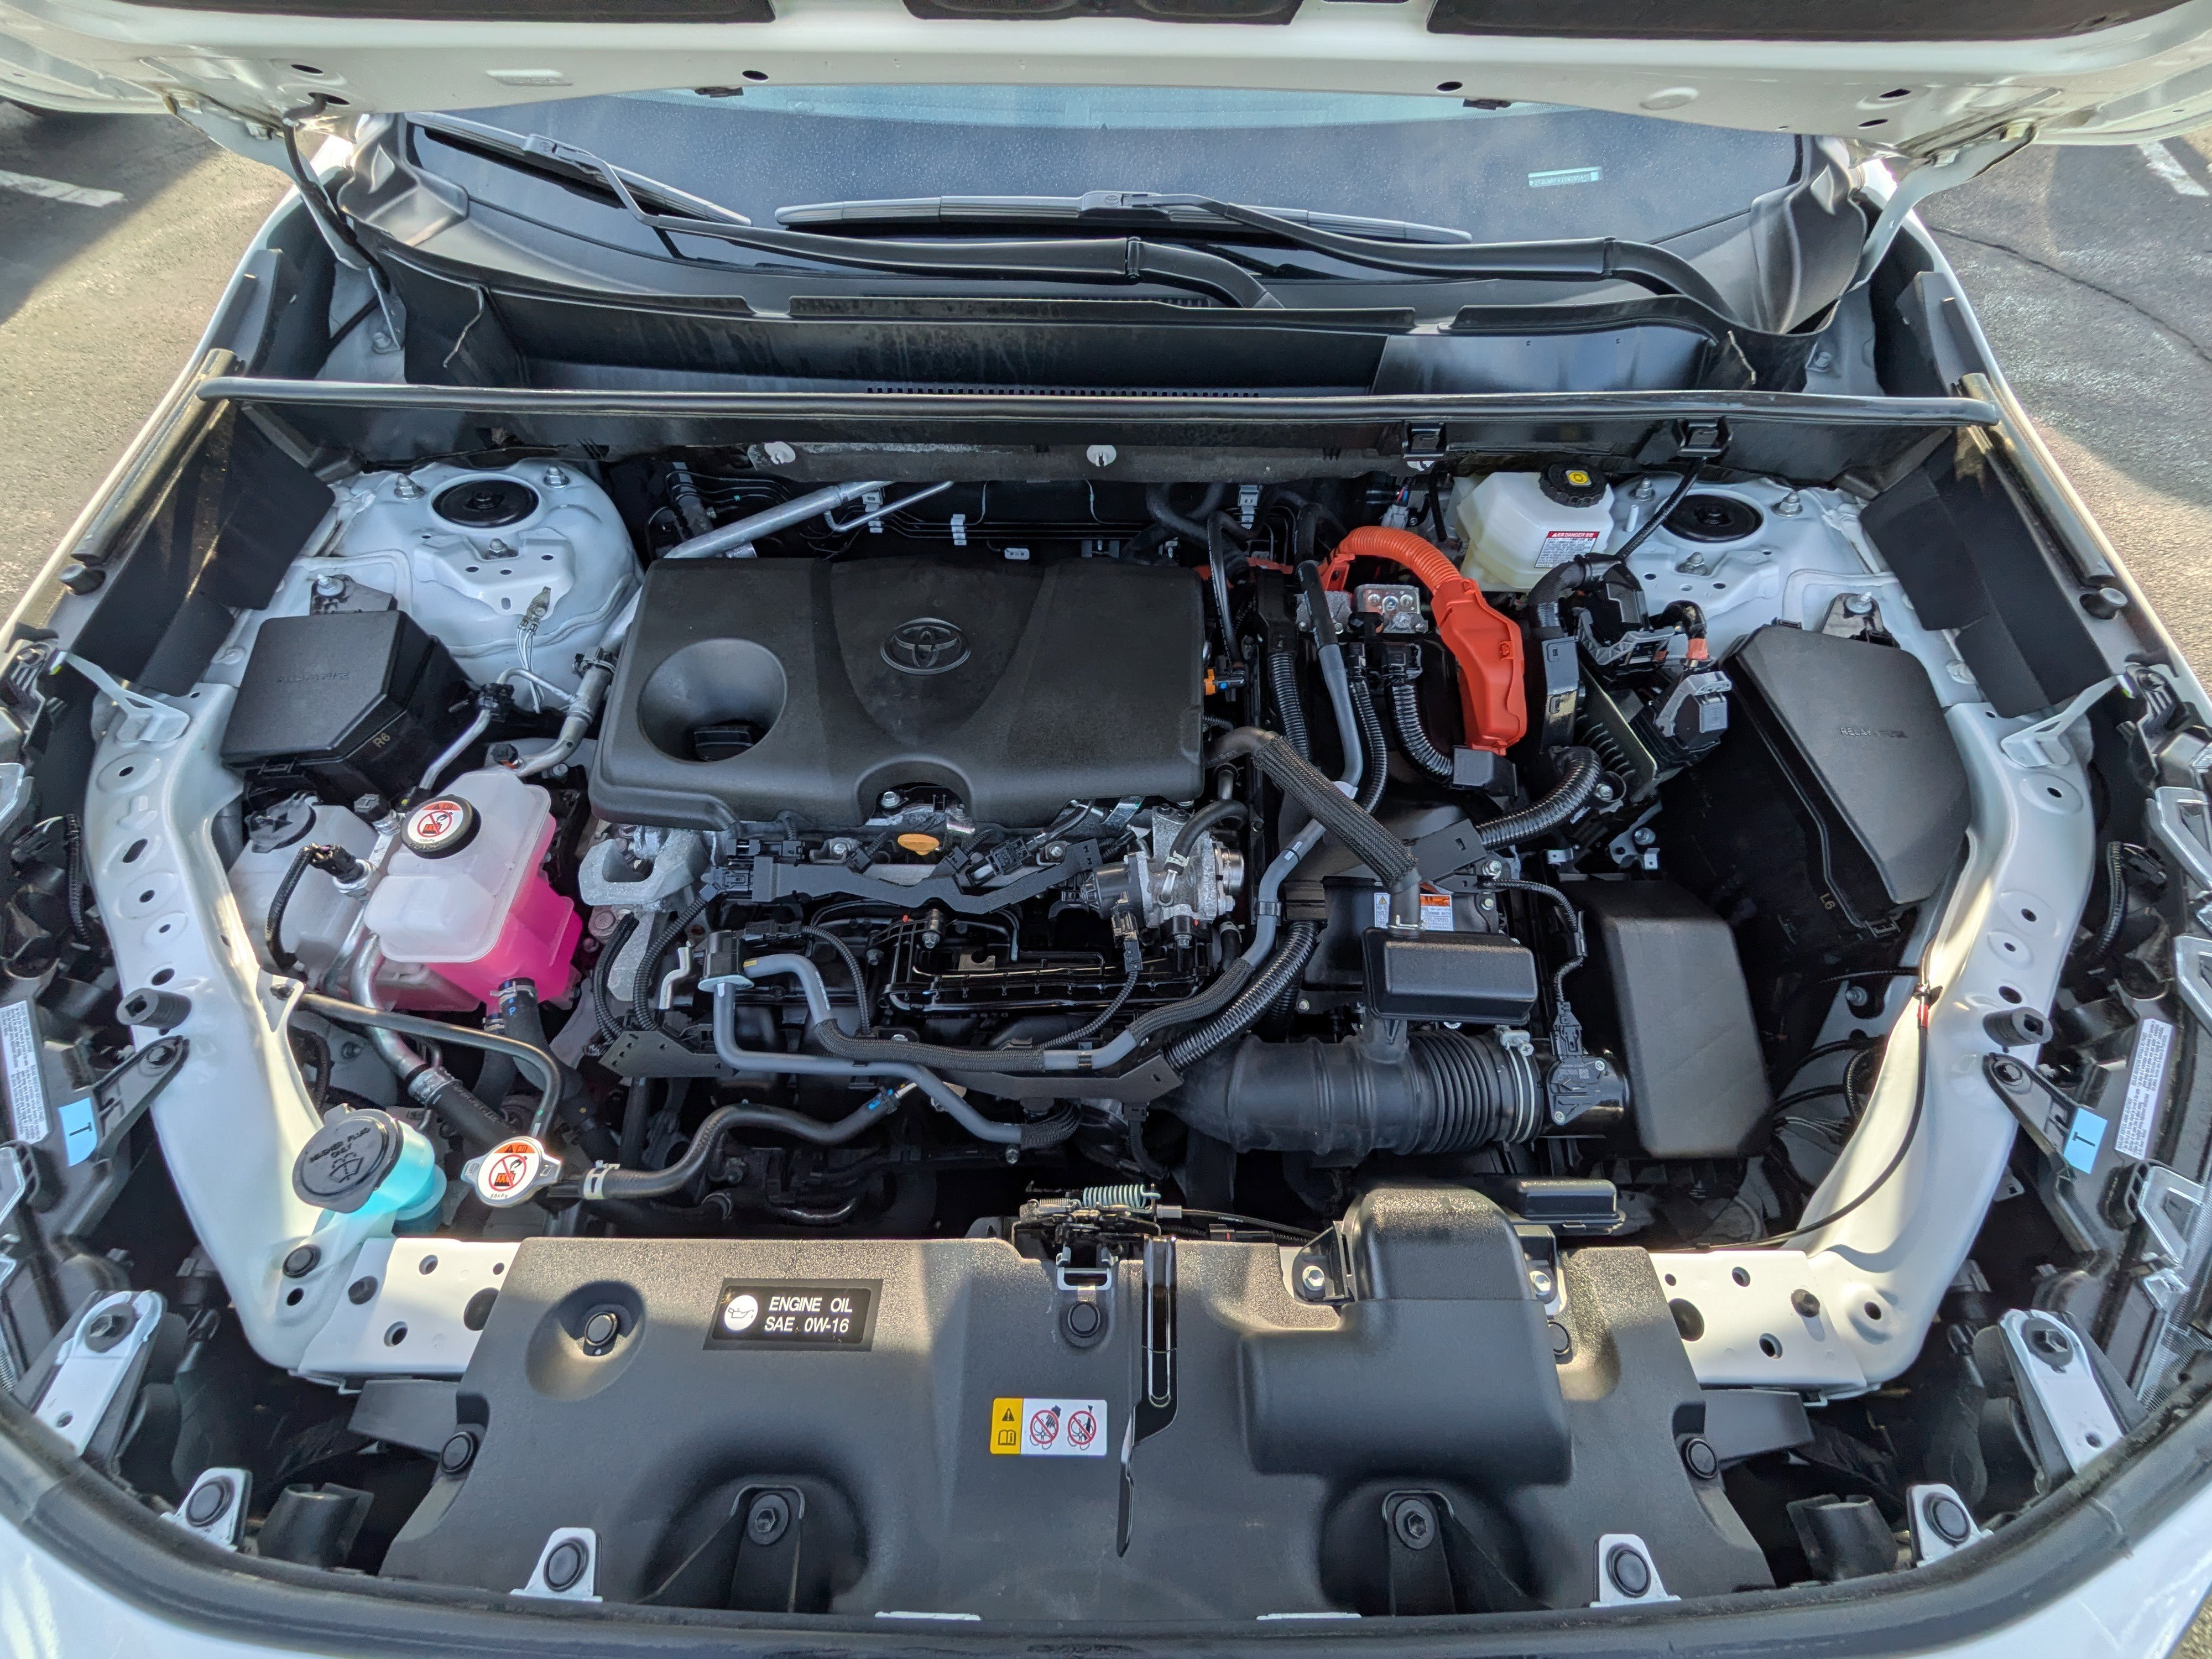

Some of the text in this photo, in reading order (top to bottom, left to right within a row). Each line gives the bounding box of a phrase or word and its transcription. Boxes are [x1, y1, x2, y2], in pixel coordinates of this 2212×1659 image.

[1840, 727, 1871, 736] RELAY
[372, 733, 390, 748] R6
[1819, 893, 1835, 910] L6
[69, 1121, 92, 1136] T
[2072, 1131, 2096, 1147] T
[769, 1296, 853, 1313] ENGINE OIL
[764, 1316, 849, 1333] SAE 0W-16
